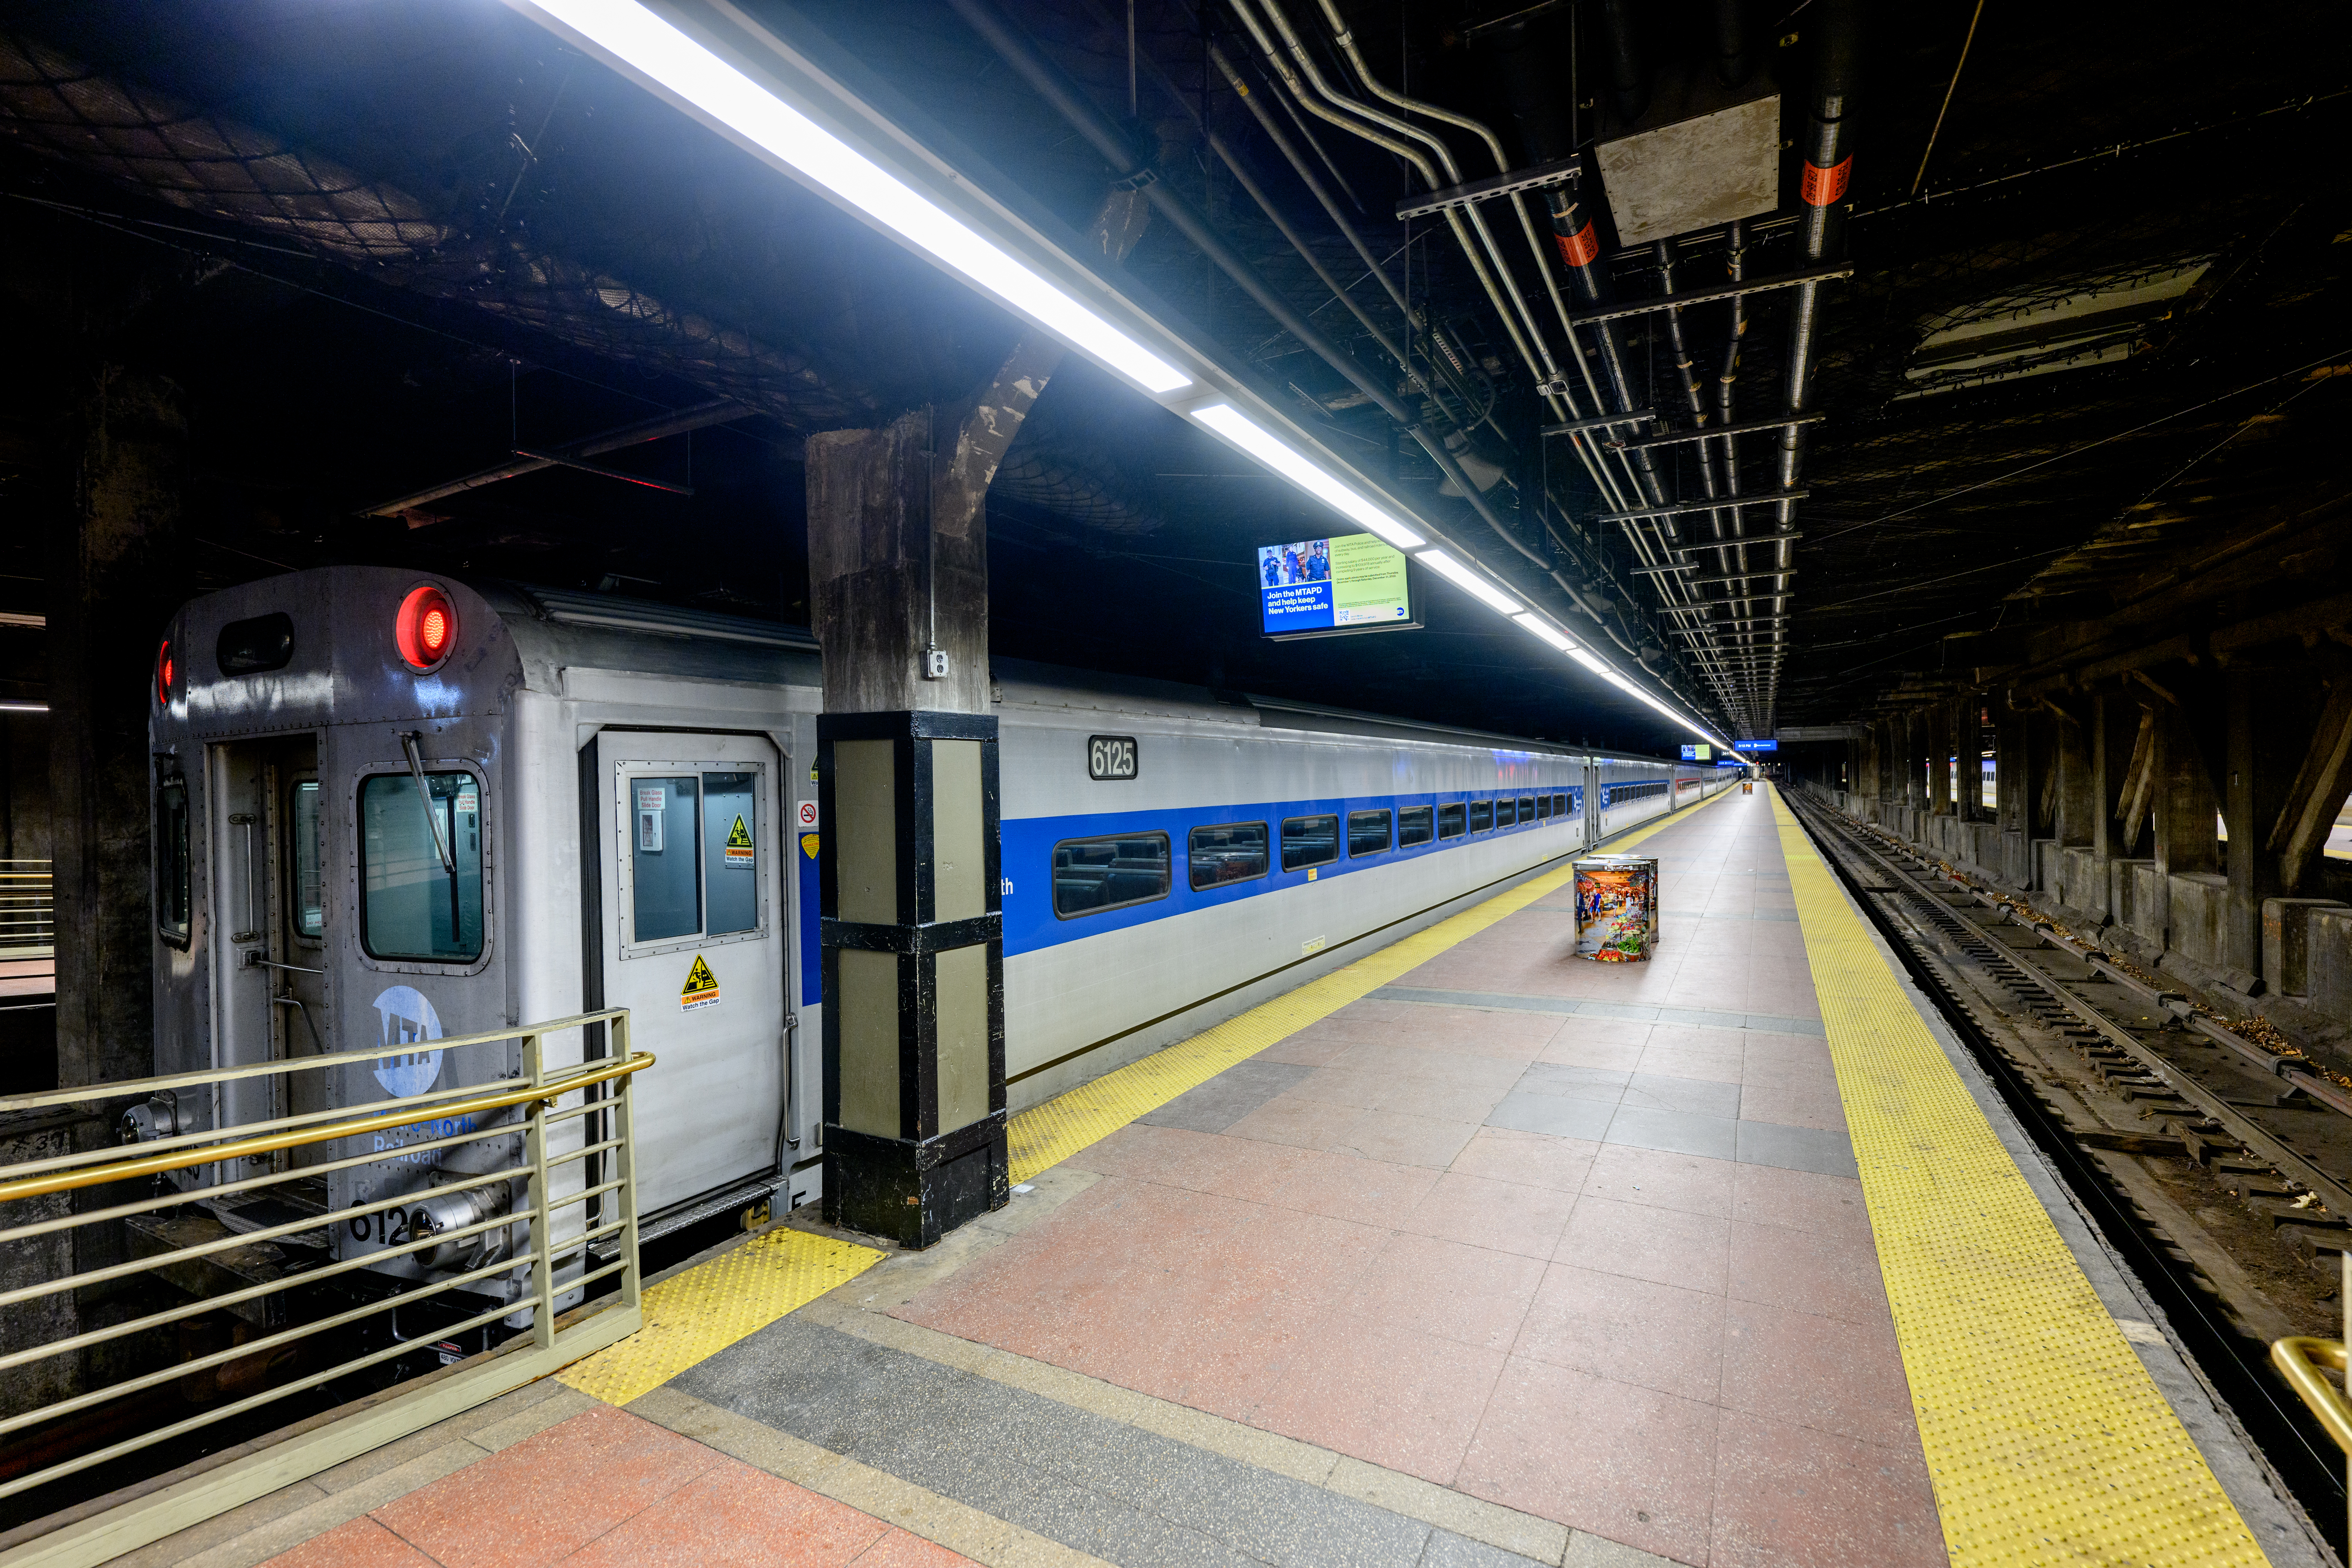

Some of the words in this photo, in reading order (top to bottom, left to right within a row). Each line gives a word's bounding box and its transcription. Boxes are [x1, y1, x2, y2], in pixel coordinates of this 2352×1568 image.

[1295, 586, 1322, 596] MTAPD
[1284, 605, 1312, 613] Yorkers
[1092, 740, 1133, 775] 6125
[692, 992, 716, 1001] WARNING
[349, 1199, 409, 1246] 612
